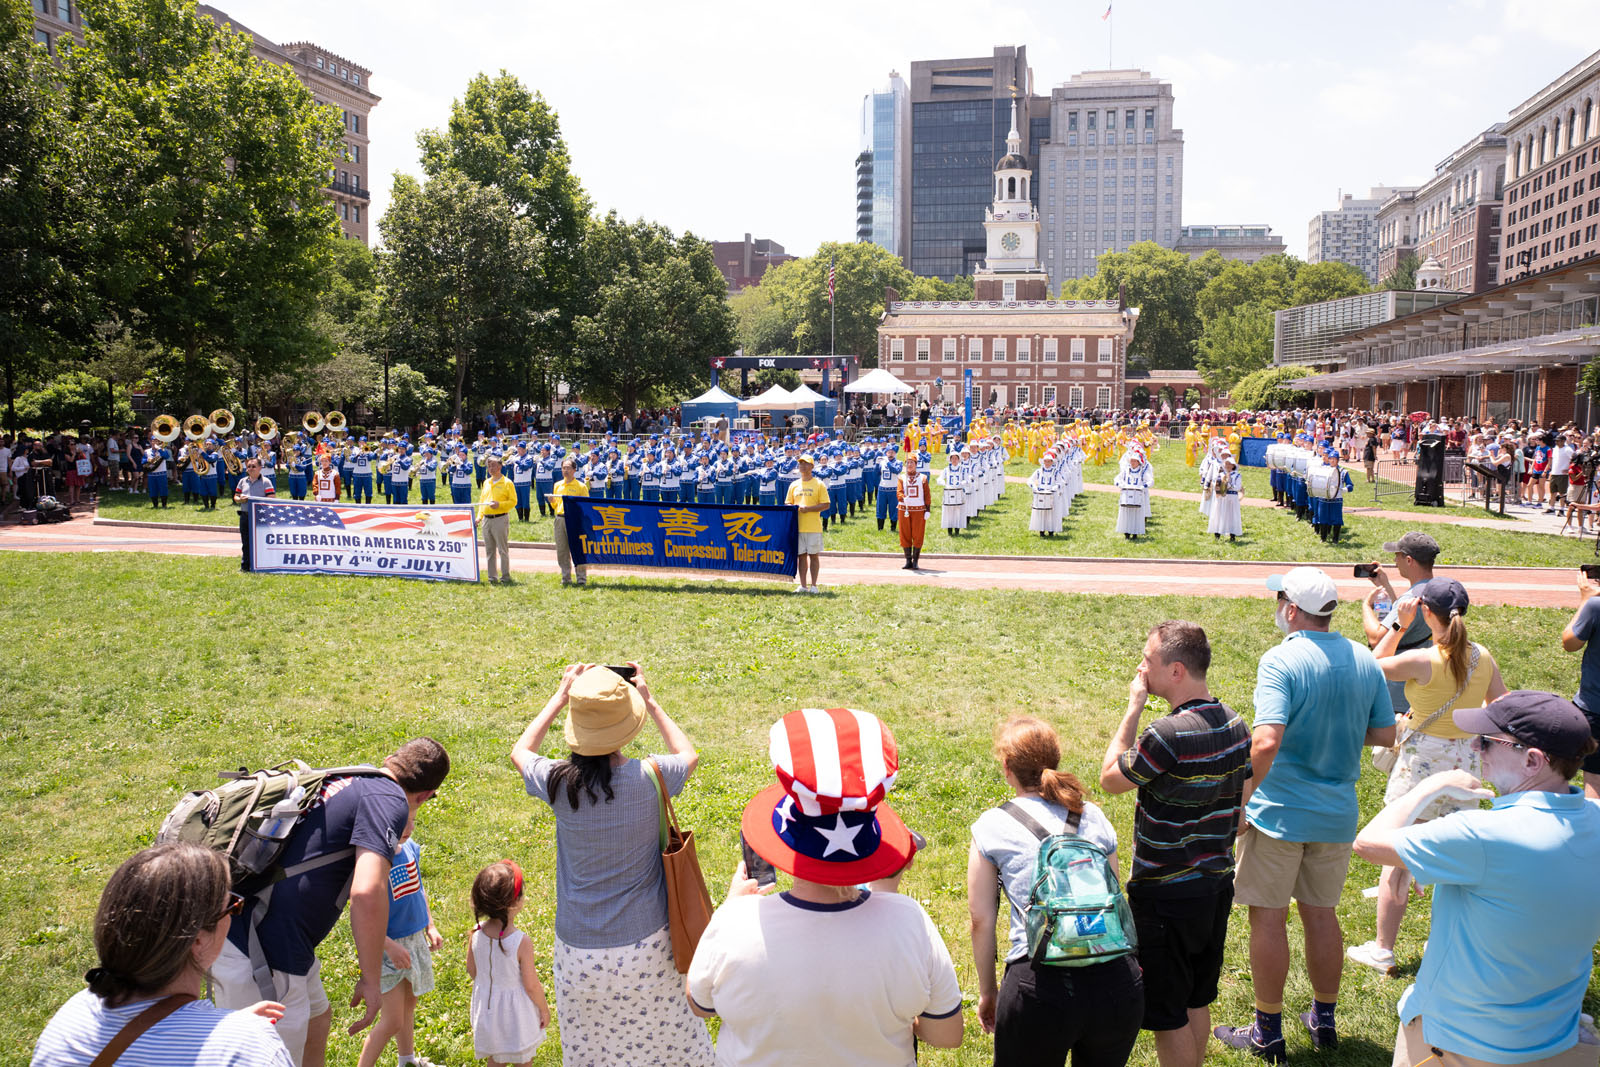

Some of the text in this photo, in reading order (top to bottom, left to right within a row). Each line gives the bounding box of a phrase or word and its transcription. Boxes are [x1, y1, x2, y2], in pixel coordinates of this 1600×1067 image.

[758, 358, 776, 368] FOX
[592, 505, 773, 543] 真善忍
[265, 533, 361, 547] CELEBRATING
[364, 536, 435, 552] AMERICA'S
[578, 534, 785, 565] Truthfulness Compassion Tolerance
[283, 553, 344, 566] HAPPY
[376, 557, 399, 569] OF
[401, 558, 451, 573] JULY!
